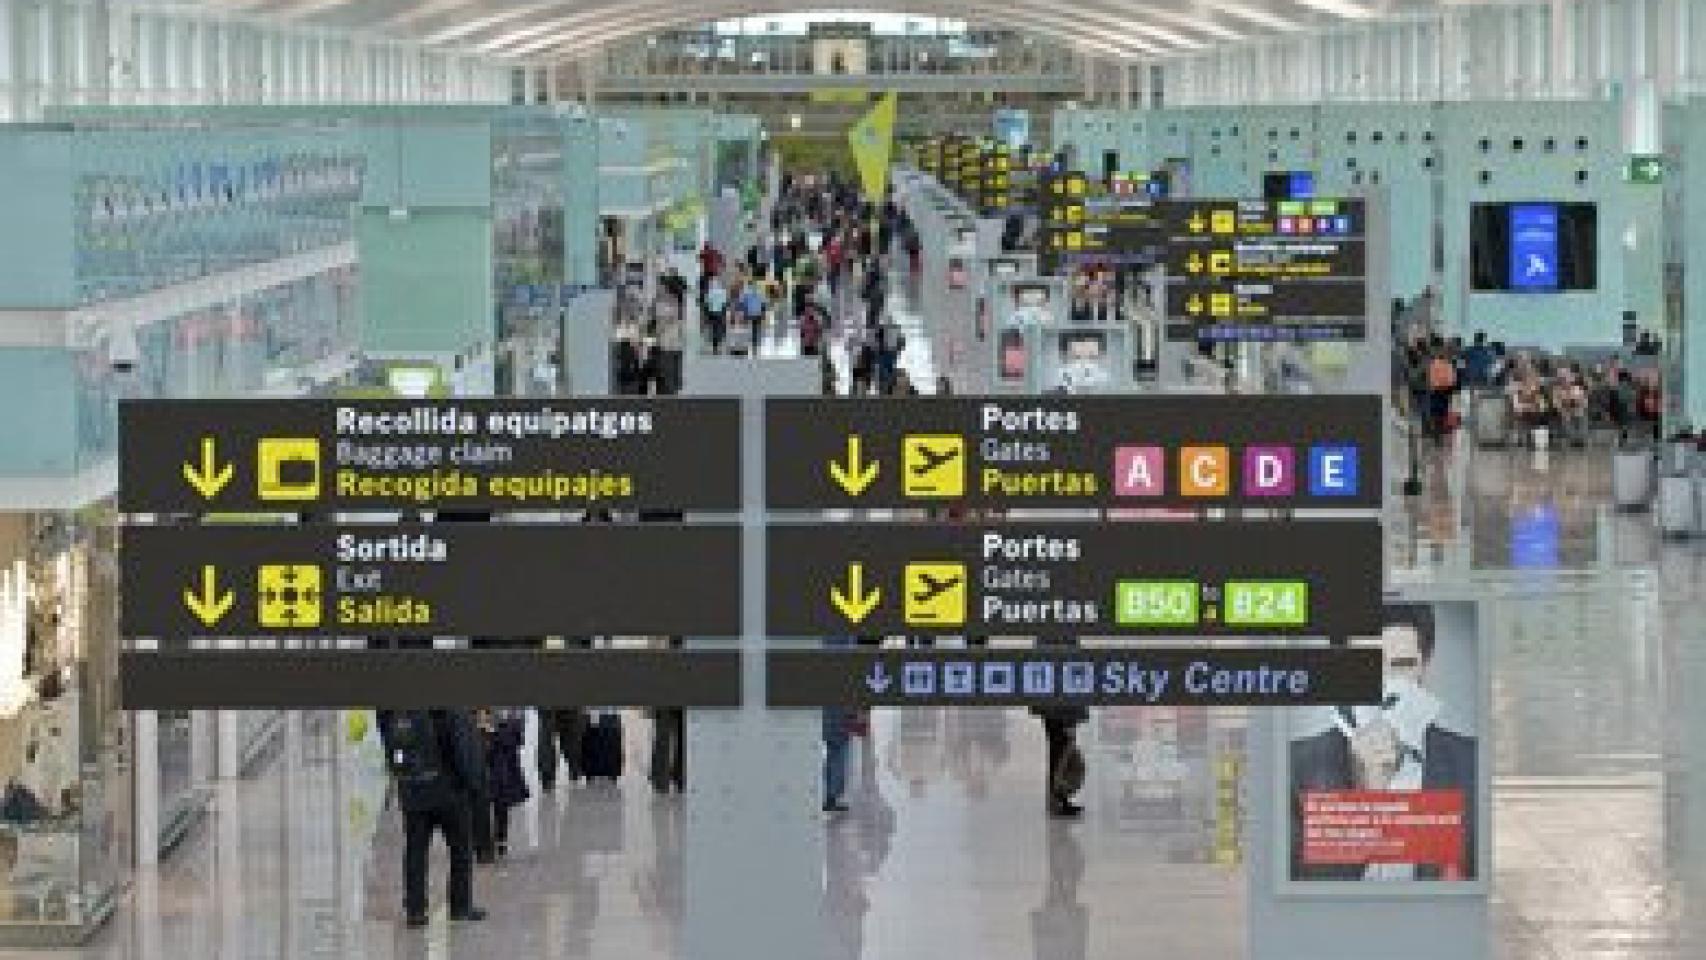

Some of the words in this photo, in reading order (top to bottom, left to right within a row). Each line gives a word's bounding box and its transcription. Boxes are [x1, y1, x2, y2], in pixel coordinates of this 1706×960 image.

[336, 407, 475, 434] Recollida
[489, 407, 653, 438] equipatges
[982, 405, 1079, 430] Portes
[981, 437, 1050, 462] Gates
[982, 469, 1098, 495] Puertas
[1126, 455, 1152, 487] A
[1190, 456, 1217, 487] C
[1257, 456, 1282, 487] D
[1322, 456, 1344, 487] E
[336, 470, 477, 500] Recogida
[487, 470, 632, 500] equipajes
[336, 534, 447, 561] Sortida
[982, 534, 1080, 560] Portes
[982, 567, 1050, 590] Gates
[336, 598, 430, 624] Salida
[982, 596, 1098, 623] Puertas
[1101, 664, 1169, 701] Sky
[1184, 664, 1309, 694] Centre
